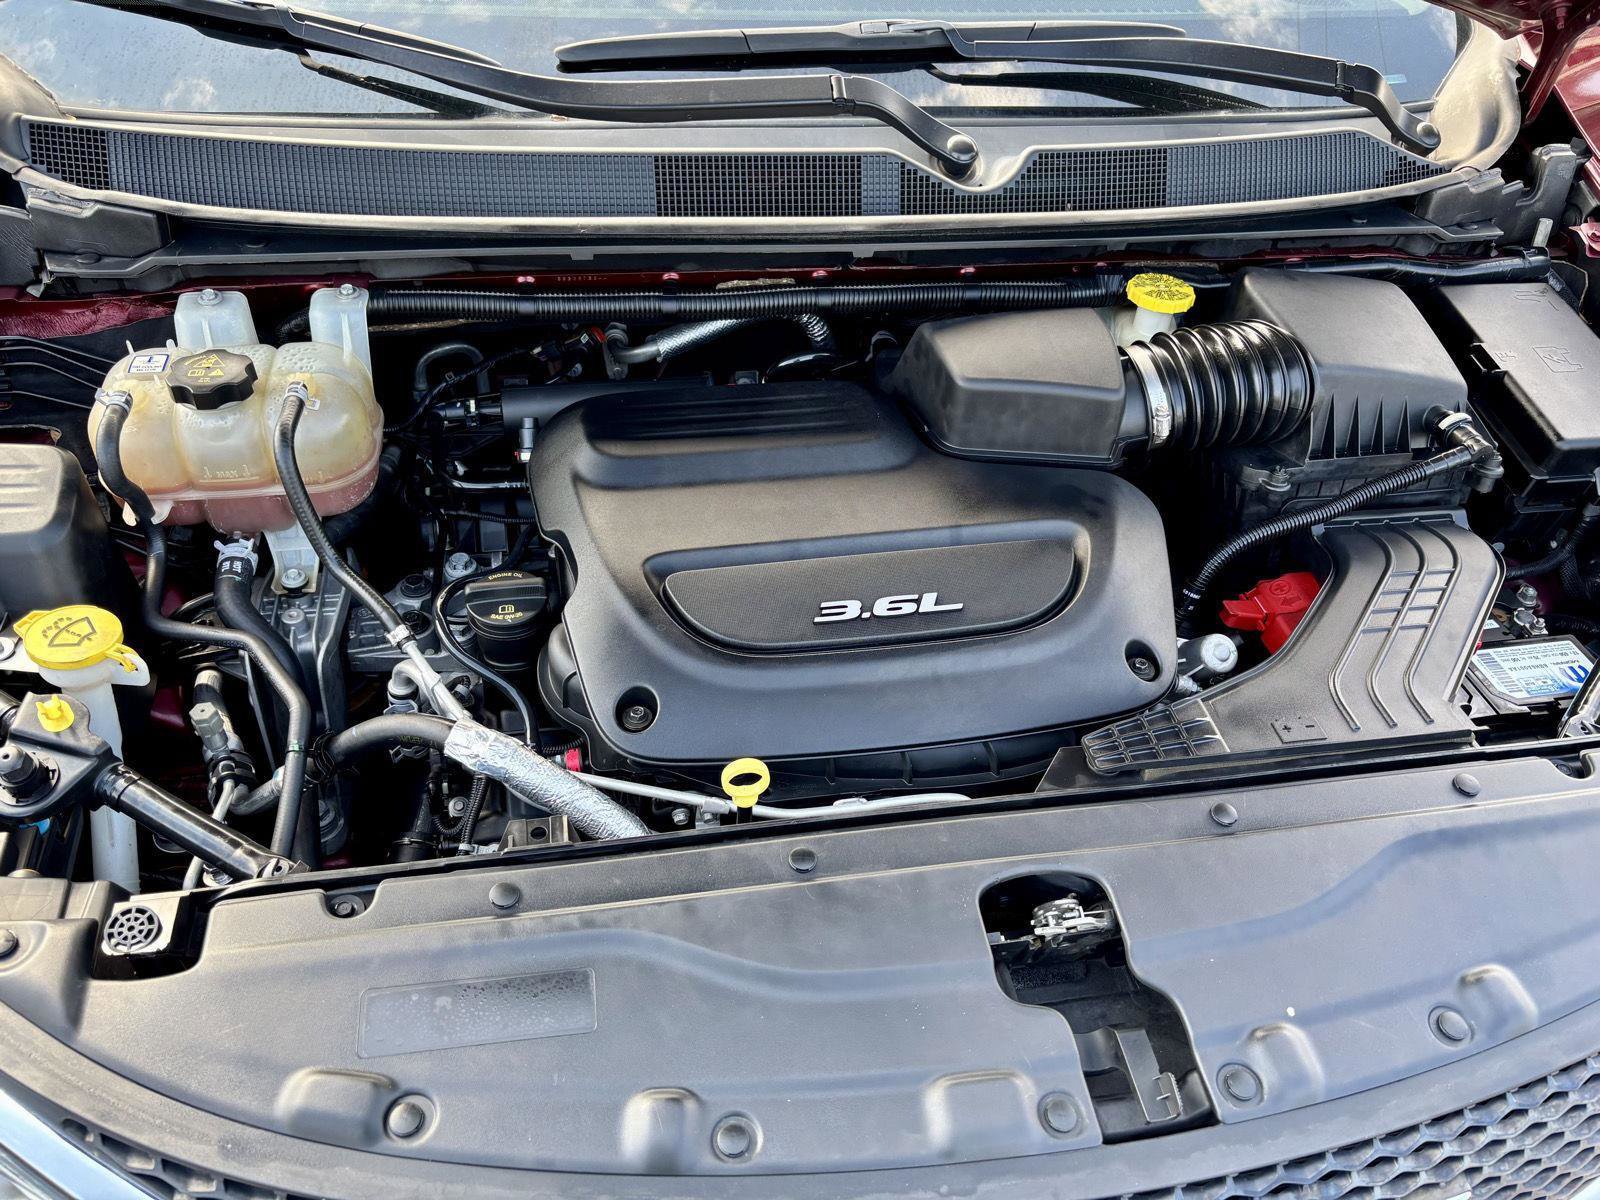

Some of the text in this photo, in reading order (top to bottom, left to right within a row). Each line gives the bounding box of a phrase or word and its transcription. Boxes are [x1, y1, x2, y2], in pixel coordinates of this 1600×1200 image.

[232, 560, 242, 573] HOT
[488, 572, 512, 581] ENGINE
[813, 592, 963, 623] 3.6L
[504, 612, 523, 620] 0W-20
